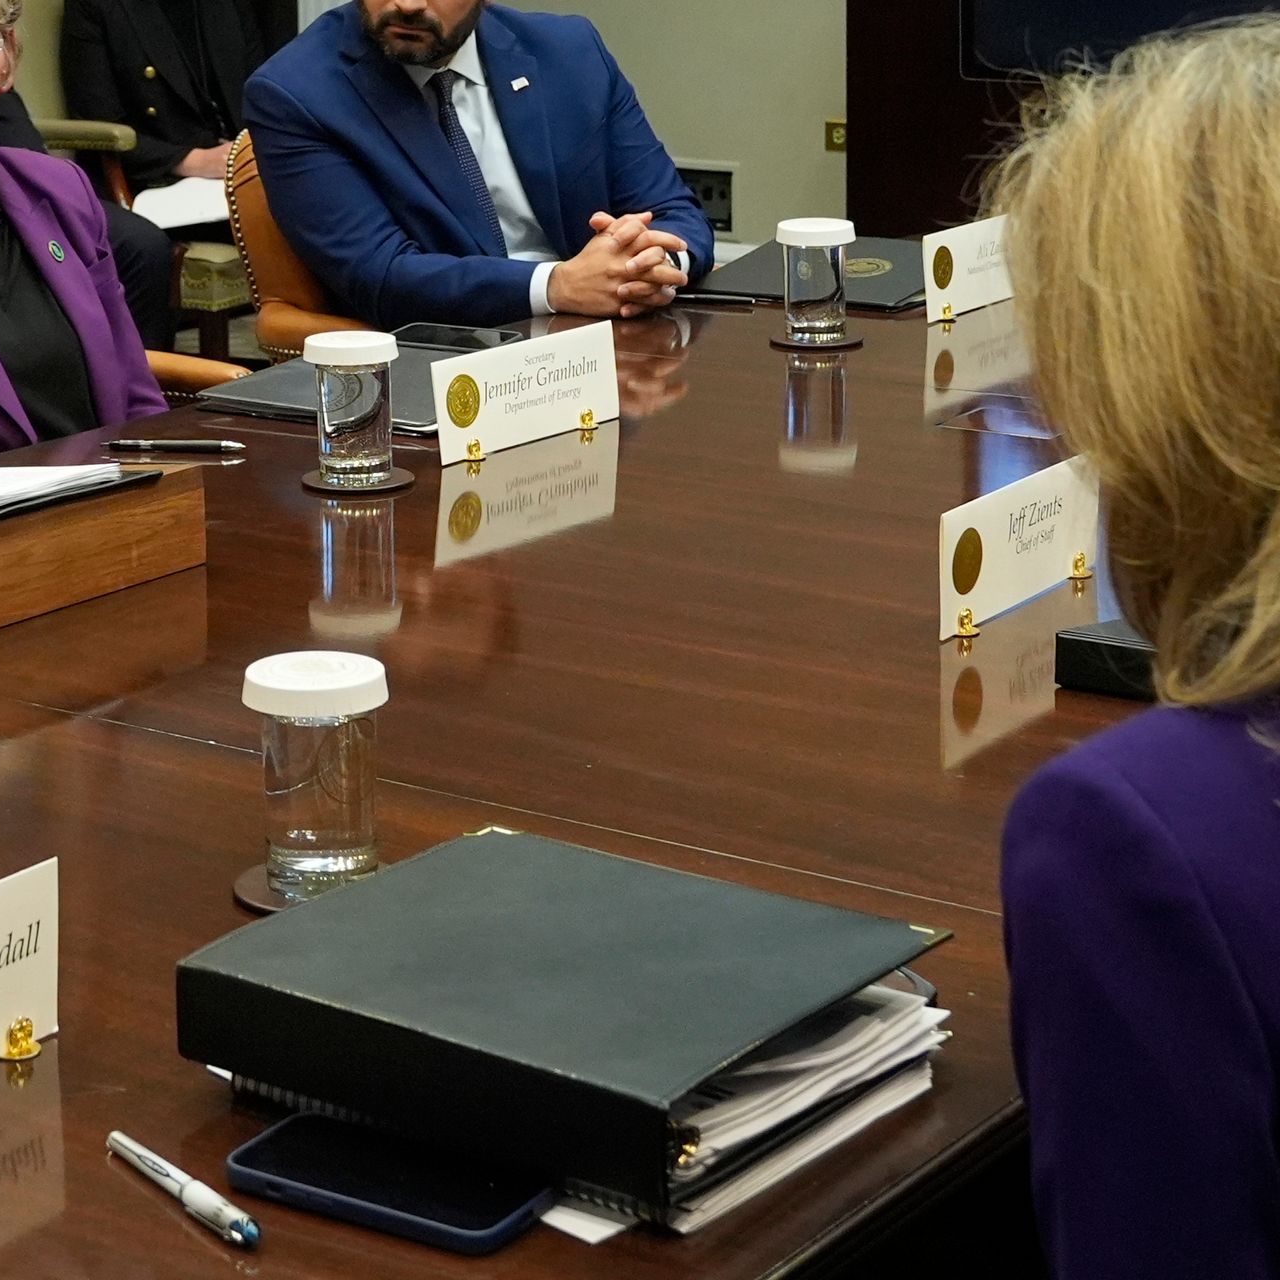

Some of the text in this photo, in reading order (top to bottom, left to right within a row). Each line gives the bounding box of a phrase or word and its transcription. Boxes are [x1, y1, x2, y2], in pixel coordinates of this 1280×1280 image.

[524, 351, 556, 366] Secretary
[484, 356, 598, 406] Jennifer Granholm
[504, 386, 582, 415] Department of Energy
[1008, 495, 1063, 542] Jeff Zients
[1016, 524, 1056, 554] Chief of Staff
